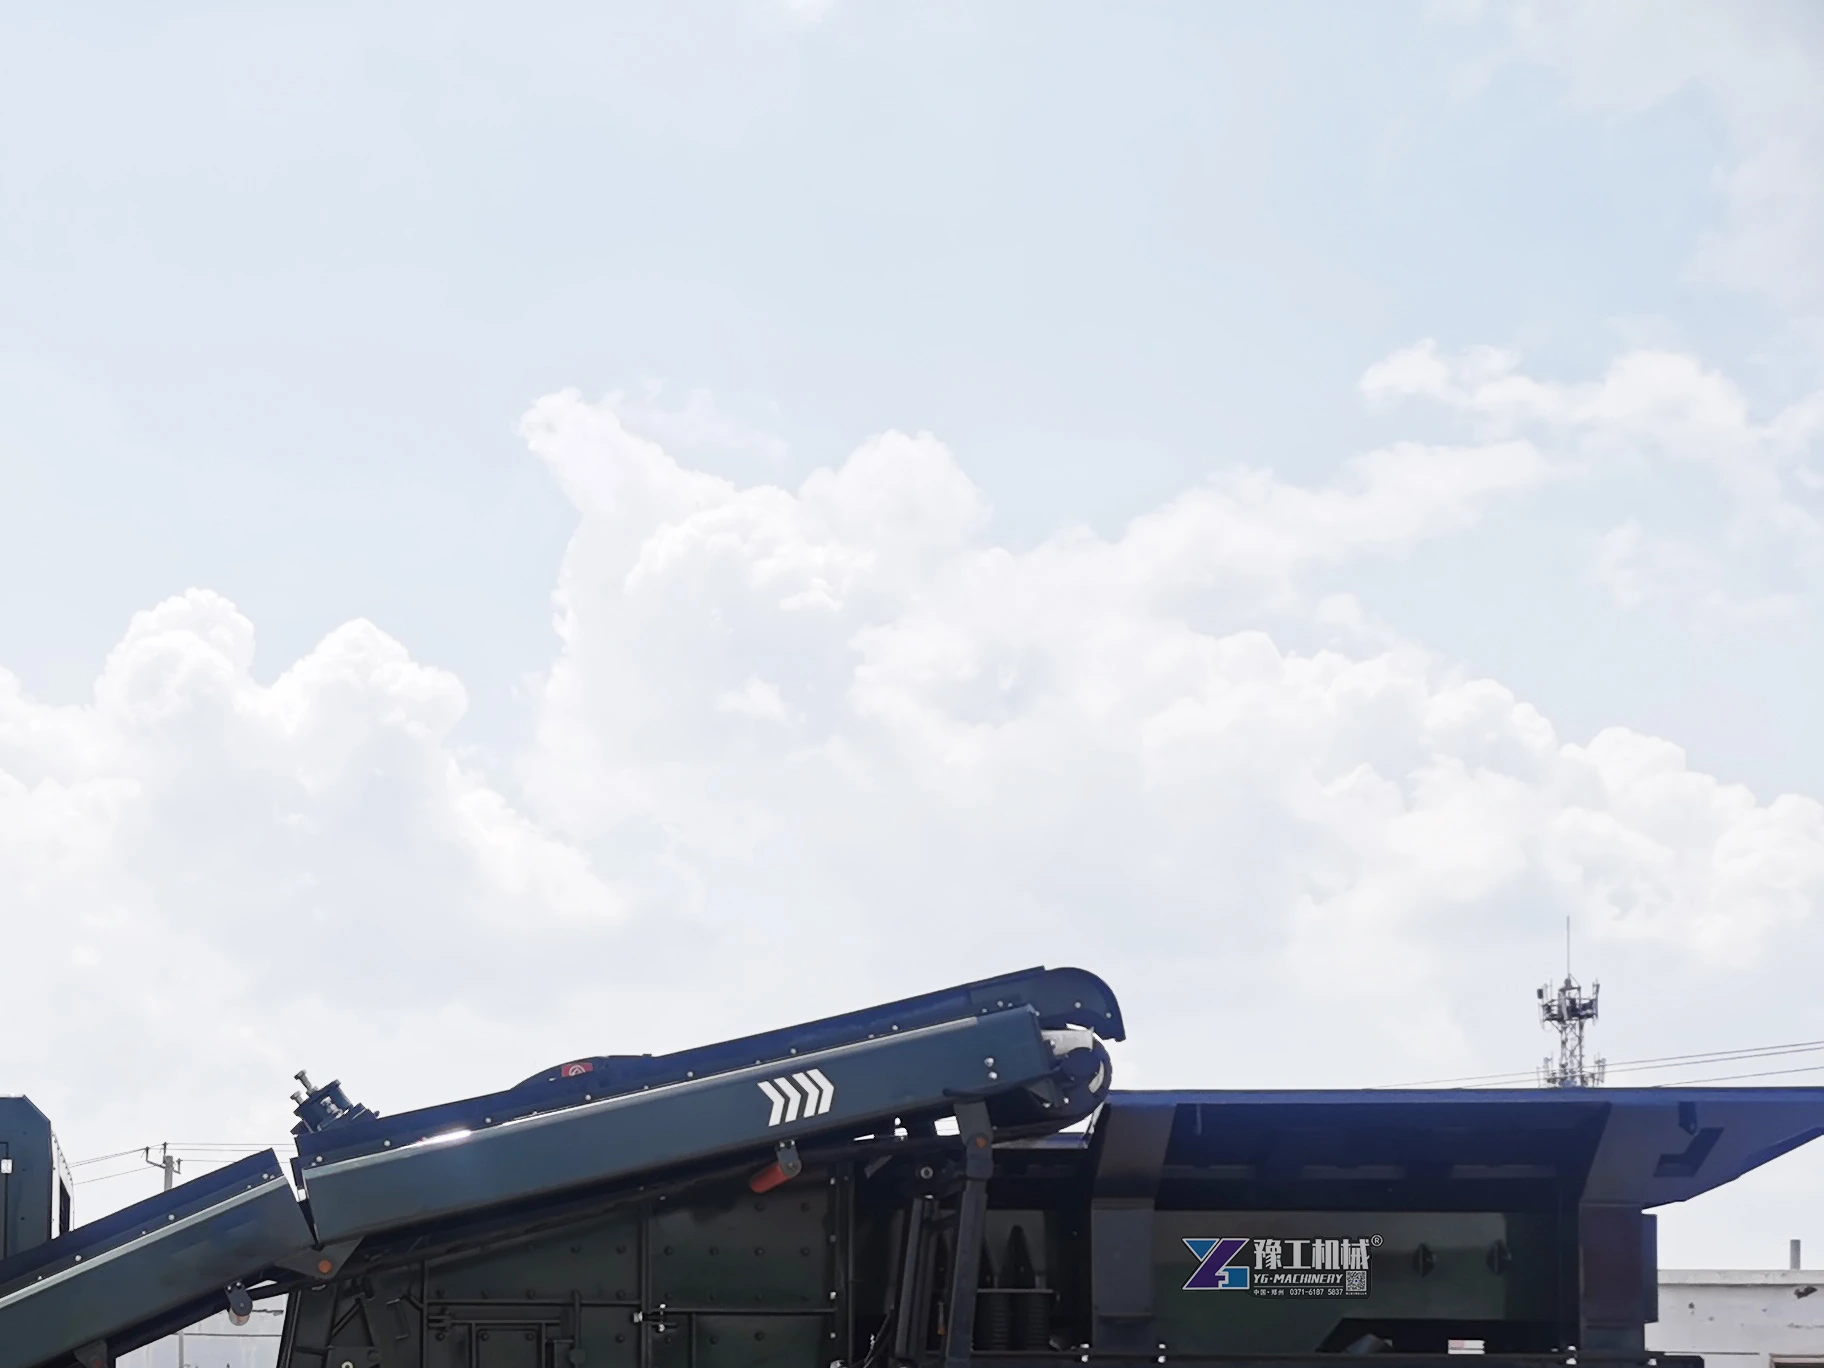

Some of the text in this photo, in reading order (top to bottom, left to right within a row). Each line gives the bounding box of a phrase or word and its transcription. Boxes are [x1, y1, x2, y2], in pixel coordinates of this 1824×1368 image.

[1254, 1239, 1370, 1269] 豫工机械
[1289, 1288, 1324, 1296] 0371-6187
[1327, 1288, 1344, 1296] 5837
